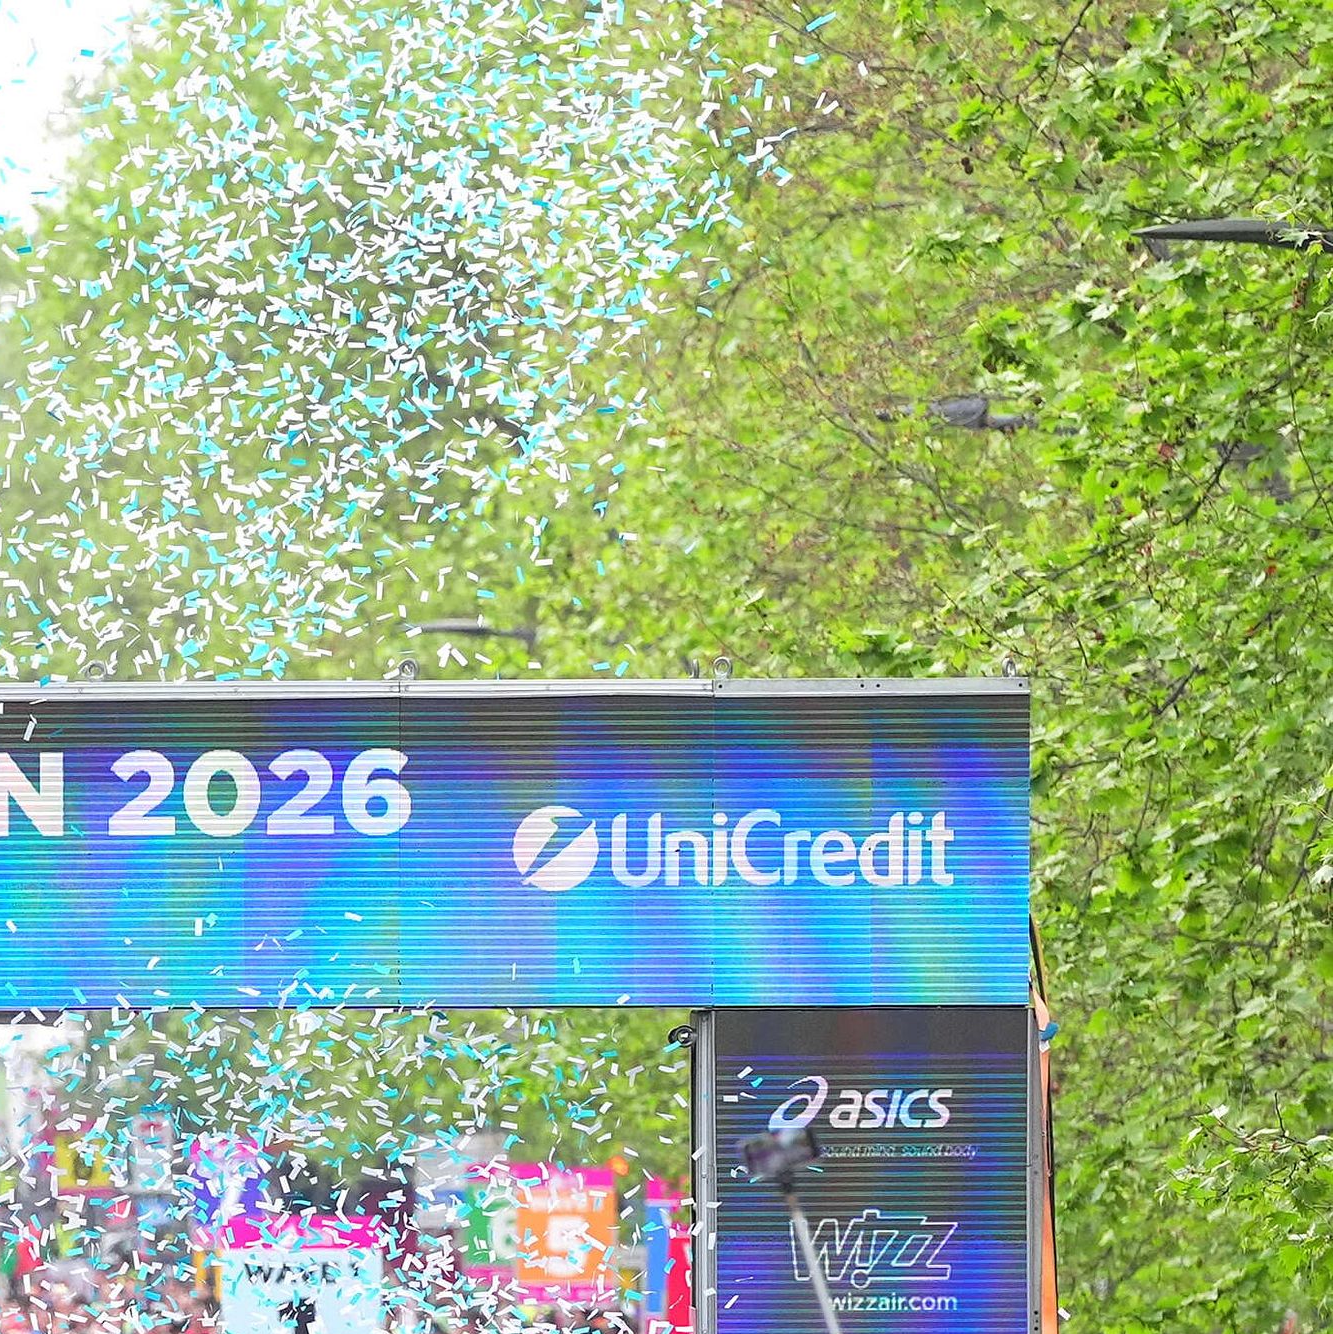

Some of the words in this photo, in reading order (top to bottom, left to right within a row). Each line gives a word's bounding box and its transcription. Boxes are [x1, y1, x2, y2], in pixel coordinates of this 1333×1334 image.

[108, 748, 414, 838] 2026
[611, 808, 955, 888] UniCredit
[832, 1293, 958, 1312] wizzair.com
